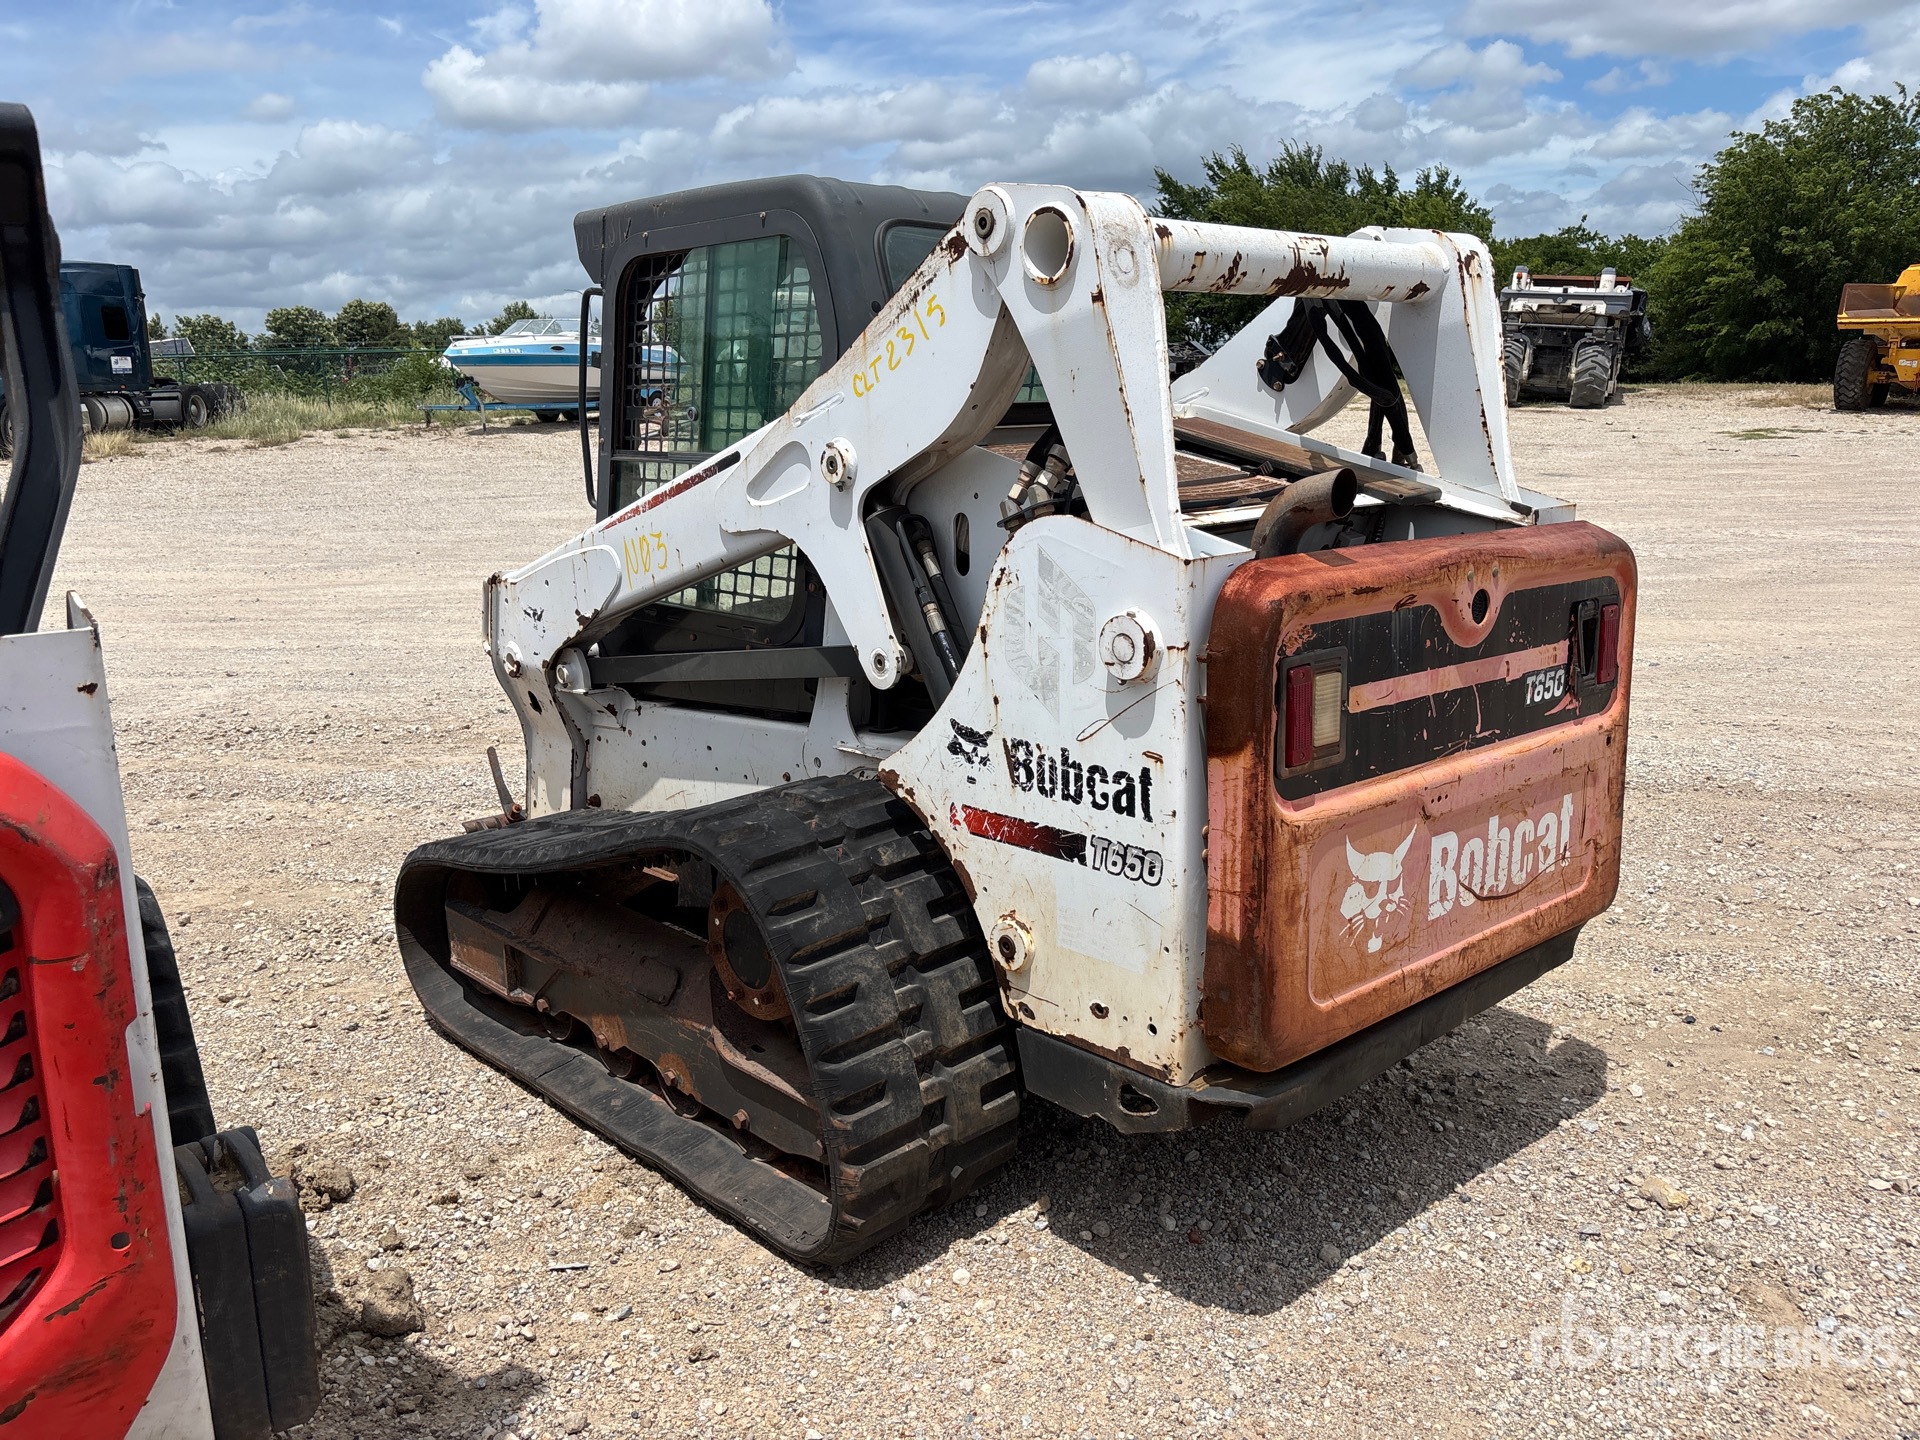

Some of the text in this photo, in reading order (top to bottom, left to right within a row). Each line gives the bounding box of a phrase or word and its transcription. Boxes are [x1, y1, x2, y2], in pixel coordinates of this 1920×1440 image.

[1526, 669, 1565, 705] T650
[1010, 737, 1154, 824] Bobcat
[1090, 834, 1164, 887] T650
[1428, 793, 1574, 921] Bobcat
